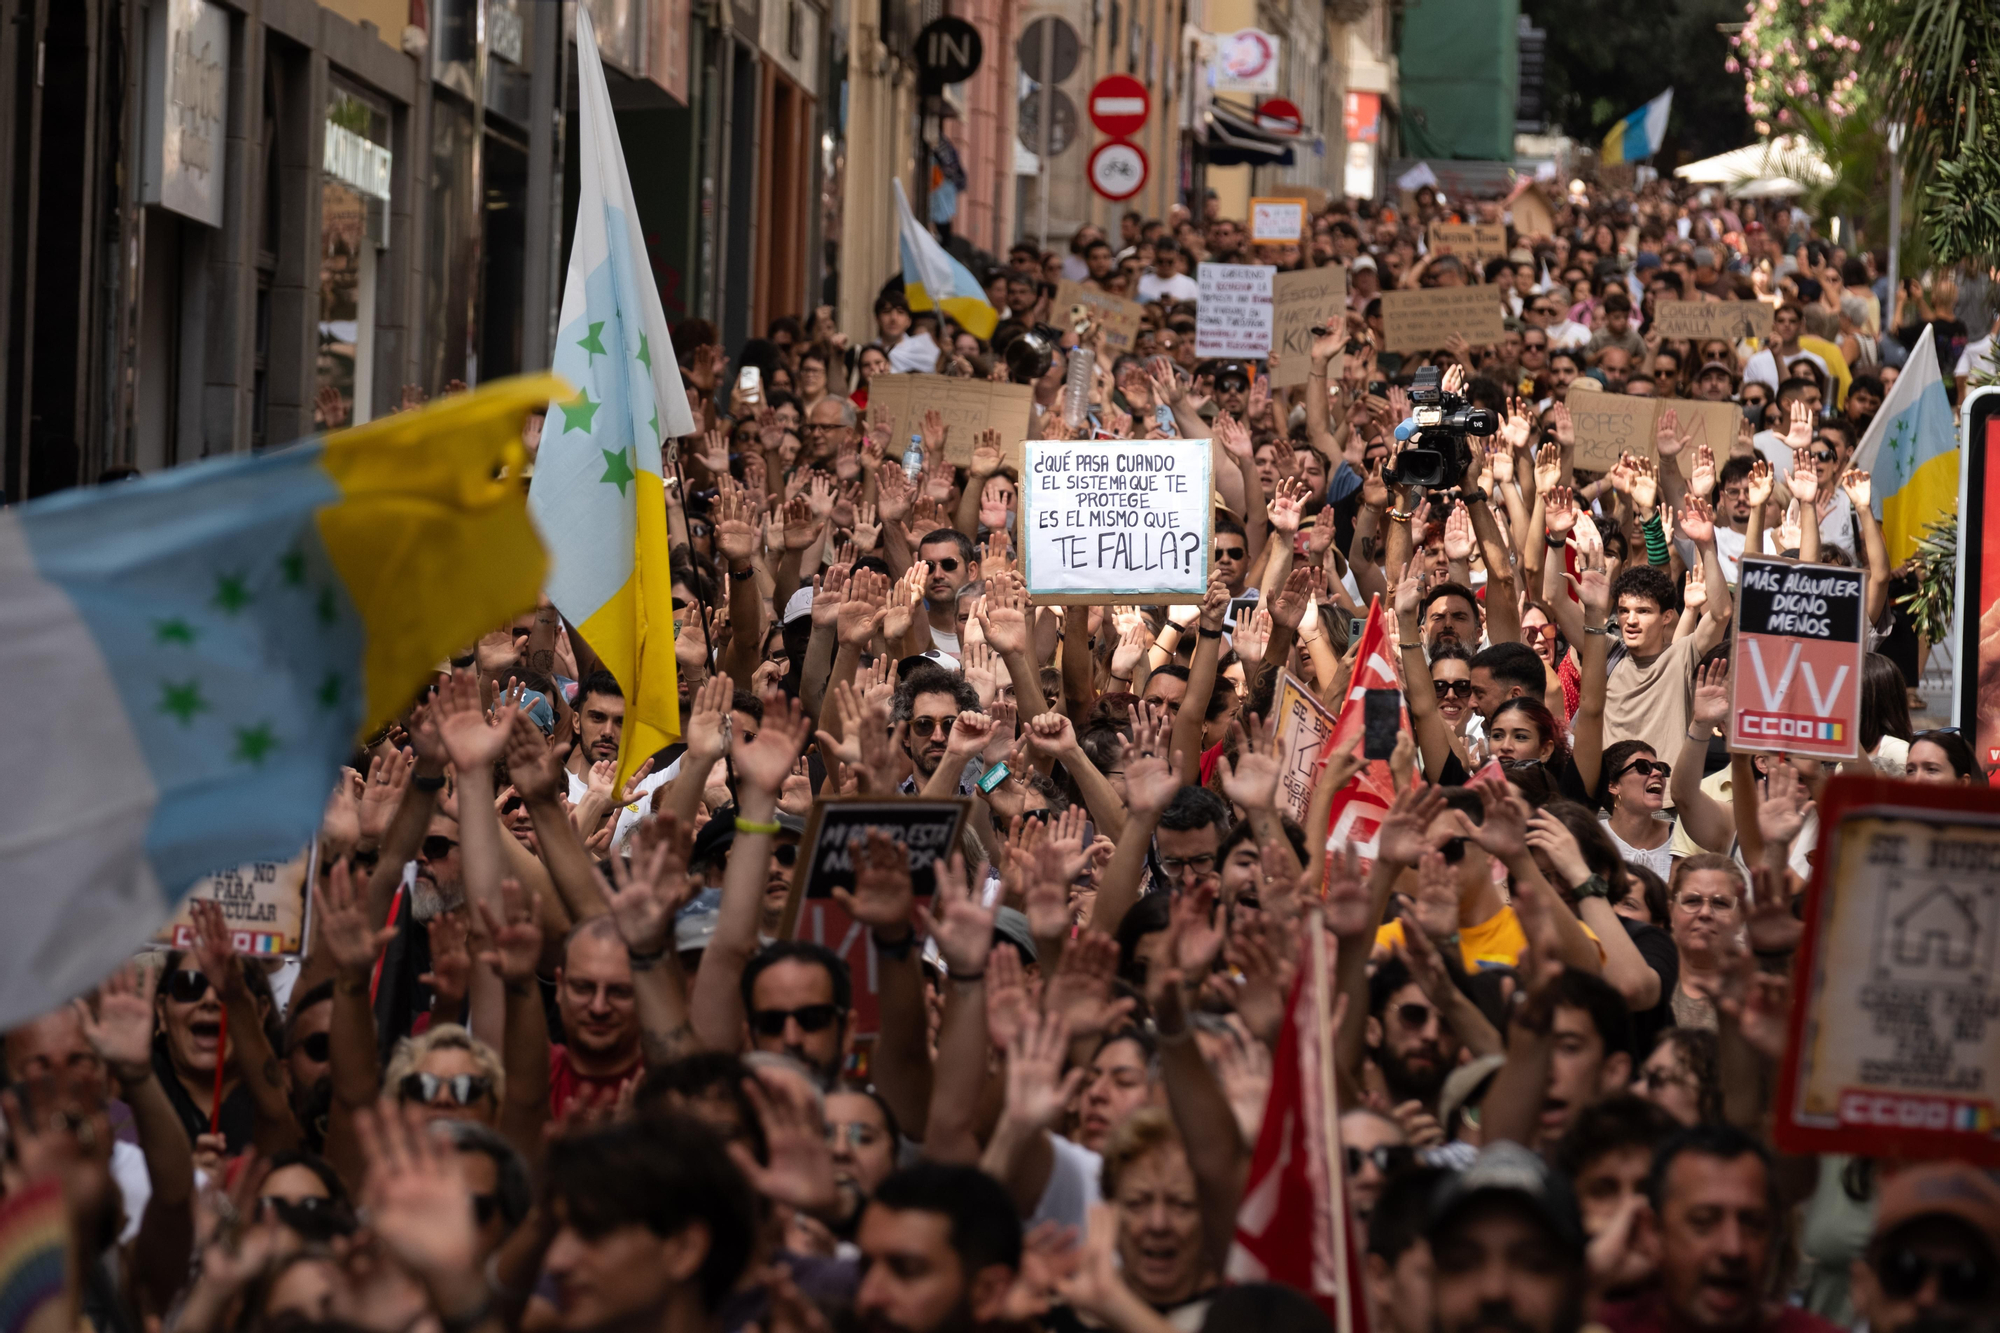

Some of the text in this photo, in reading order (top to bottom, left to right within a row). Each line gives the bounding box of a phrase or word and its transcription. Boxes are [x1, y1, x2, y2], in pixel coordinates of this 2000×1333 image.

[927, 32, 970, 68] IN
[1572, 412, 1635, 437] TOPES
[1034, 450, 1175, 473] ¿QUÉ PASA CUANDO
[1042, 474, 1188, 493] EL SISTEMA QUE TE
[1075, 492, 1151, 509] PROTEGE
[1039, 510, 1181, 529] ES EL MISMO QUE
[1051, 531, 1201, 575] TE FALLA?
[1743, 566, 1860, 598] MÁS ALQUILER
[1771, 593, 1828, 616] DIGNO
[1766, 612, 1831, 637] MENOS
[1292, 699, 1308, 722] SE
[1743, 714, 1814, 739] CCOO
[1283, 775, 1312, 804] CASAS
[253, 863, 276, 883] NO
[214, 881, 255, 901] PARA
